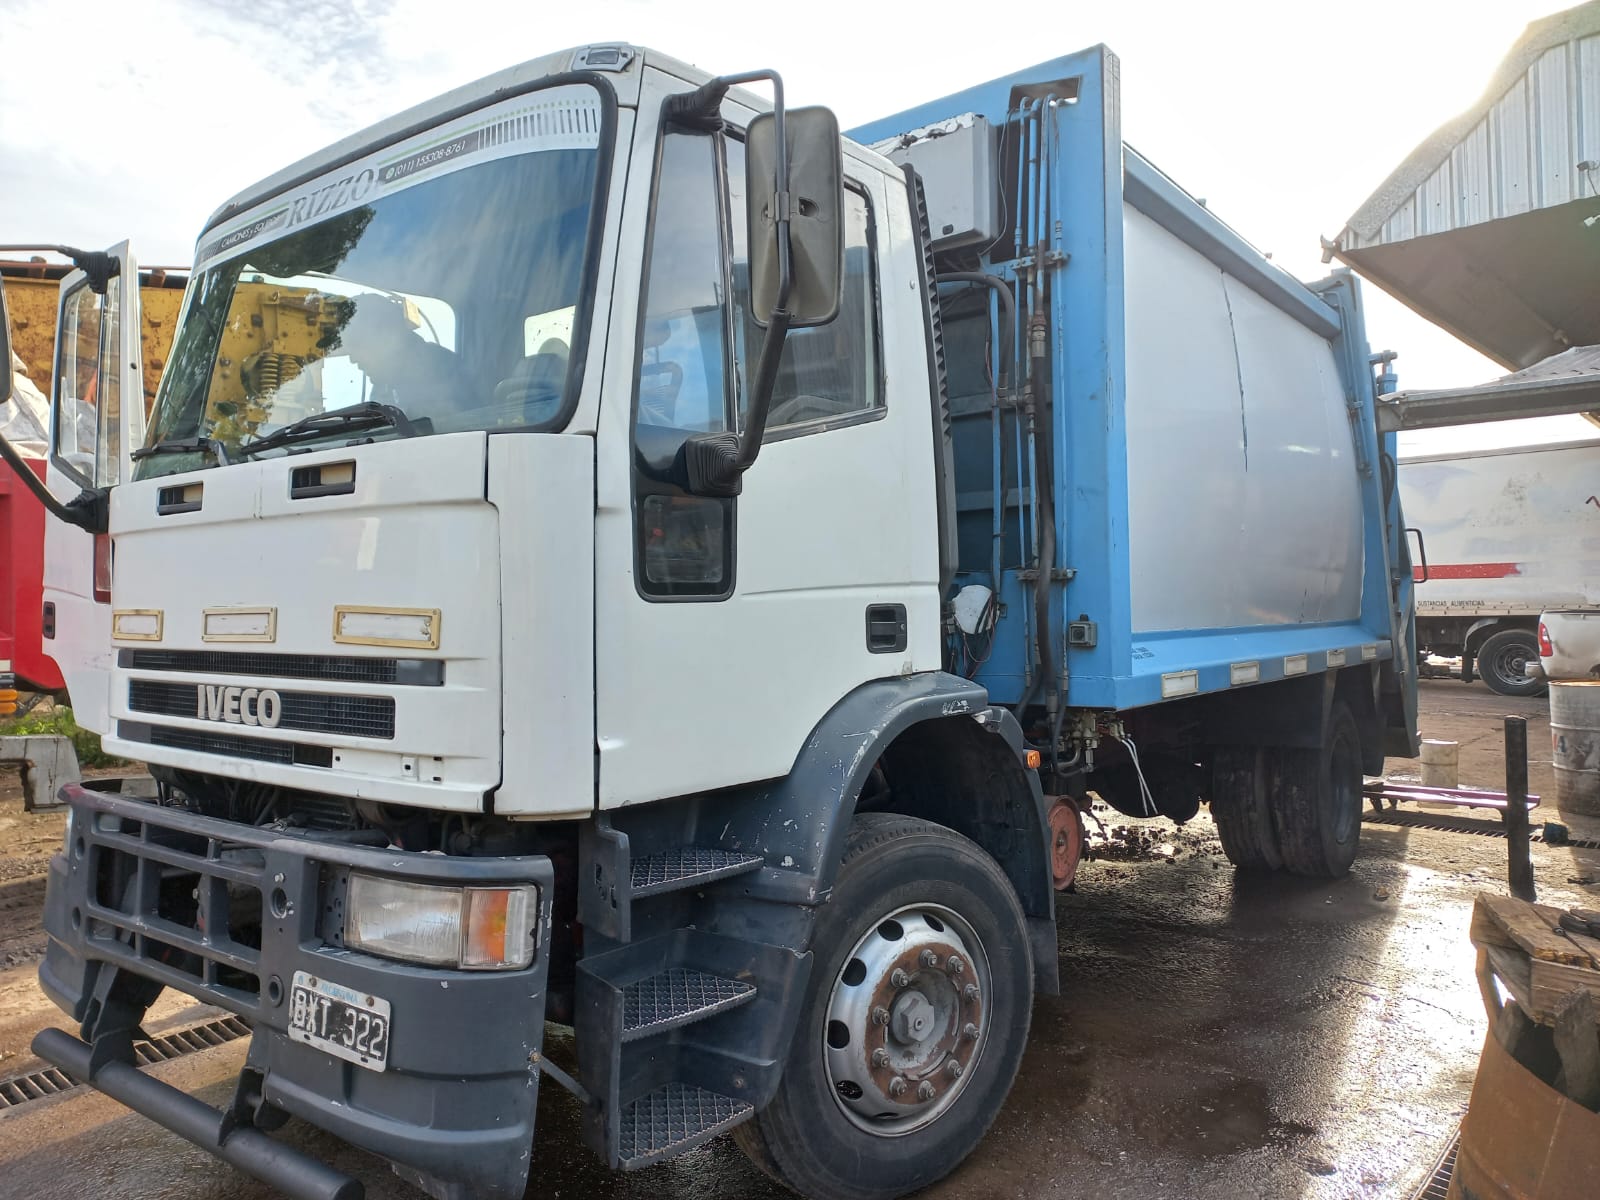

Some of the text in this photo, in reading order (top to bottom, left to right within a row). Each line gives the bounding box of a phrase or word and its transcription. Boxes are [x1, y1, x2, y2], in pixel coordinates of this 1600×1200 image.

[286, 168, 374, 228] RIZZO
[197, 684, 281, 728] IVECO
[342, 1007, 383, 1058] 322
